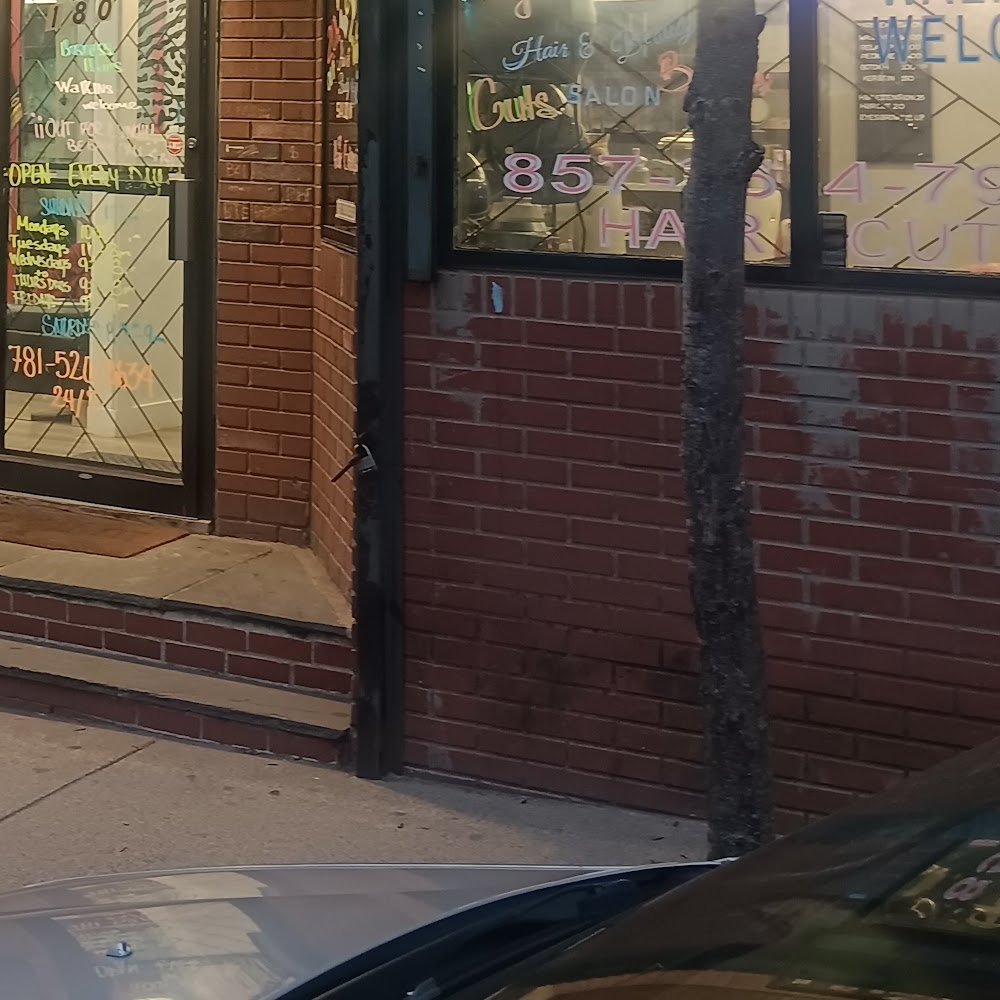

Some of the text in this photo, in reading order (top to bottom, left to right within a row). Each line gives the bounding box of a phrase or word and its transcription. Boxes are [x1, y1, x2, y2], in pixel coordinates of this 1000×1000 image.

[502, 34, 568, 71] Hair
[566, 84, 661, 107] SALON
[8, 161, 52, 187] OPEN
[600, 207, 762, 254] HAR
